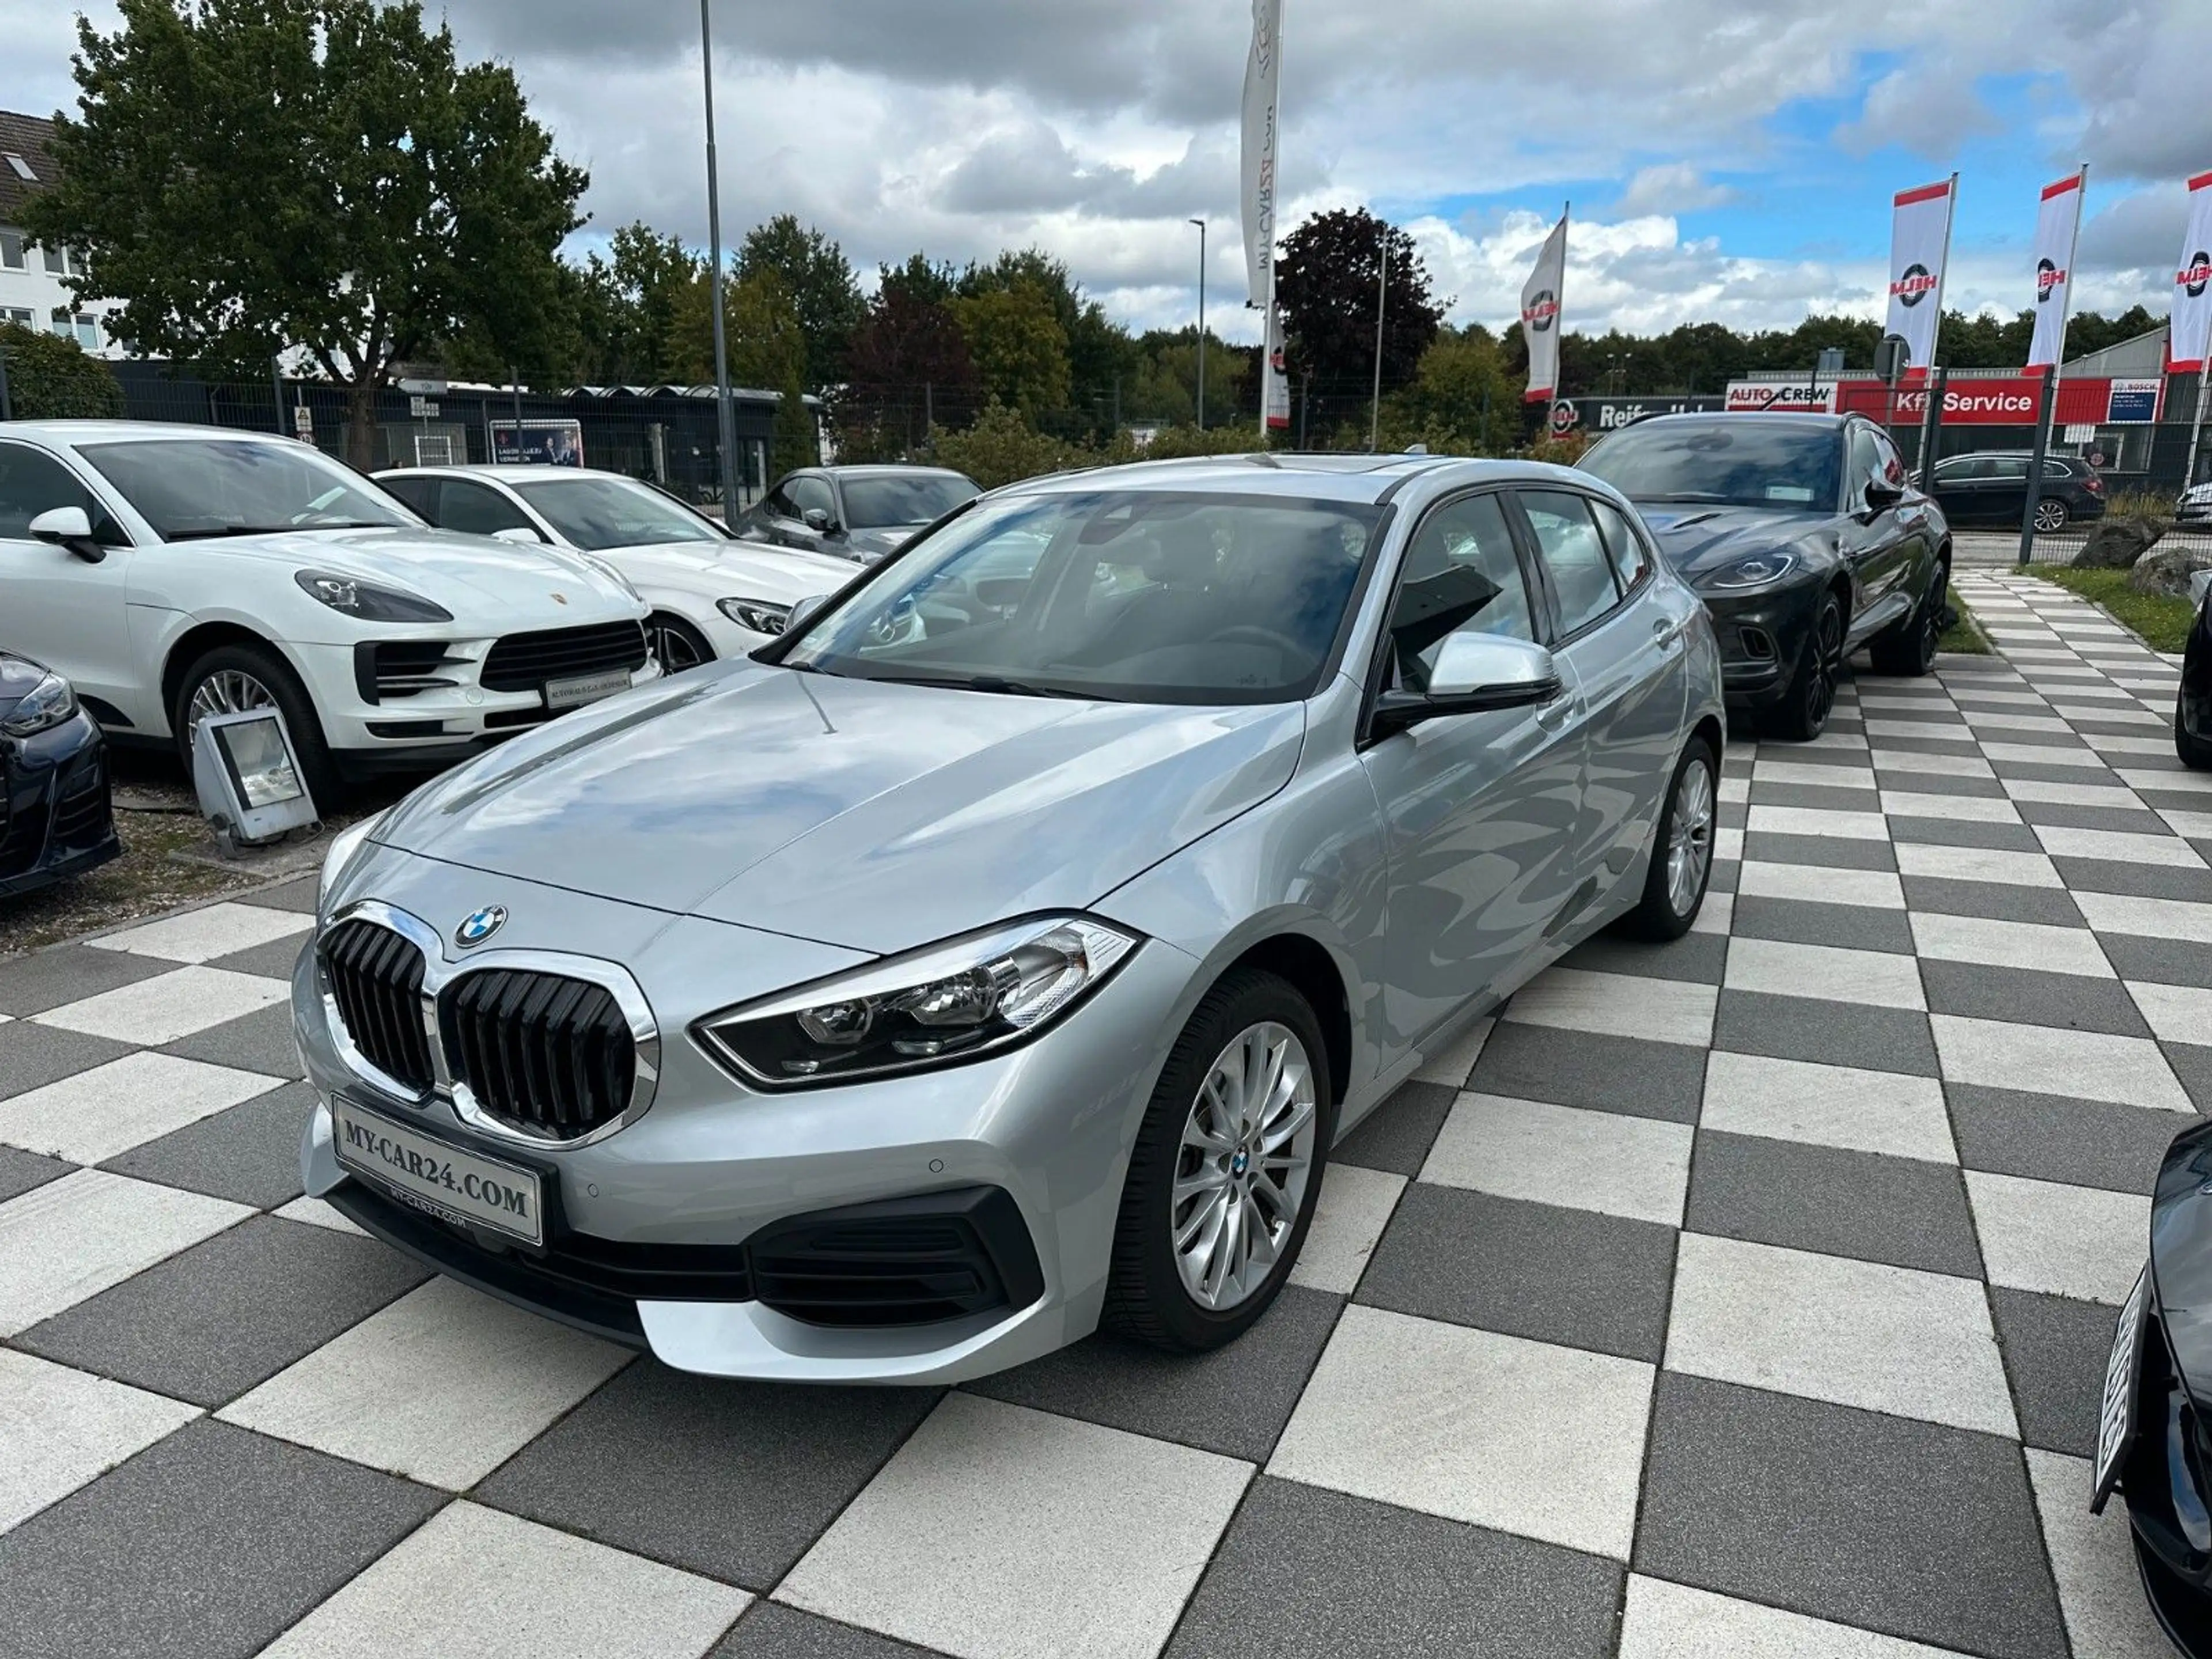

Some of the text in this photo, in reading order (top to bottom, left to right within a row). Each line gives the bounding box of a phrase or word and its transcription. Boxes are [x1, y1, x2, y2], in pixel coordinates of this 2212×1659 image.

[1599, 404, 1650, 428] Reif
[1942, 392, 2032, 412] Service
[344, 1120, 529, 1218] MY-CAR24.COM
[390, 1187, 466, 1228] MY-CAR24.COM
